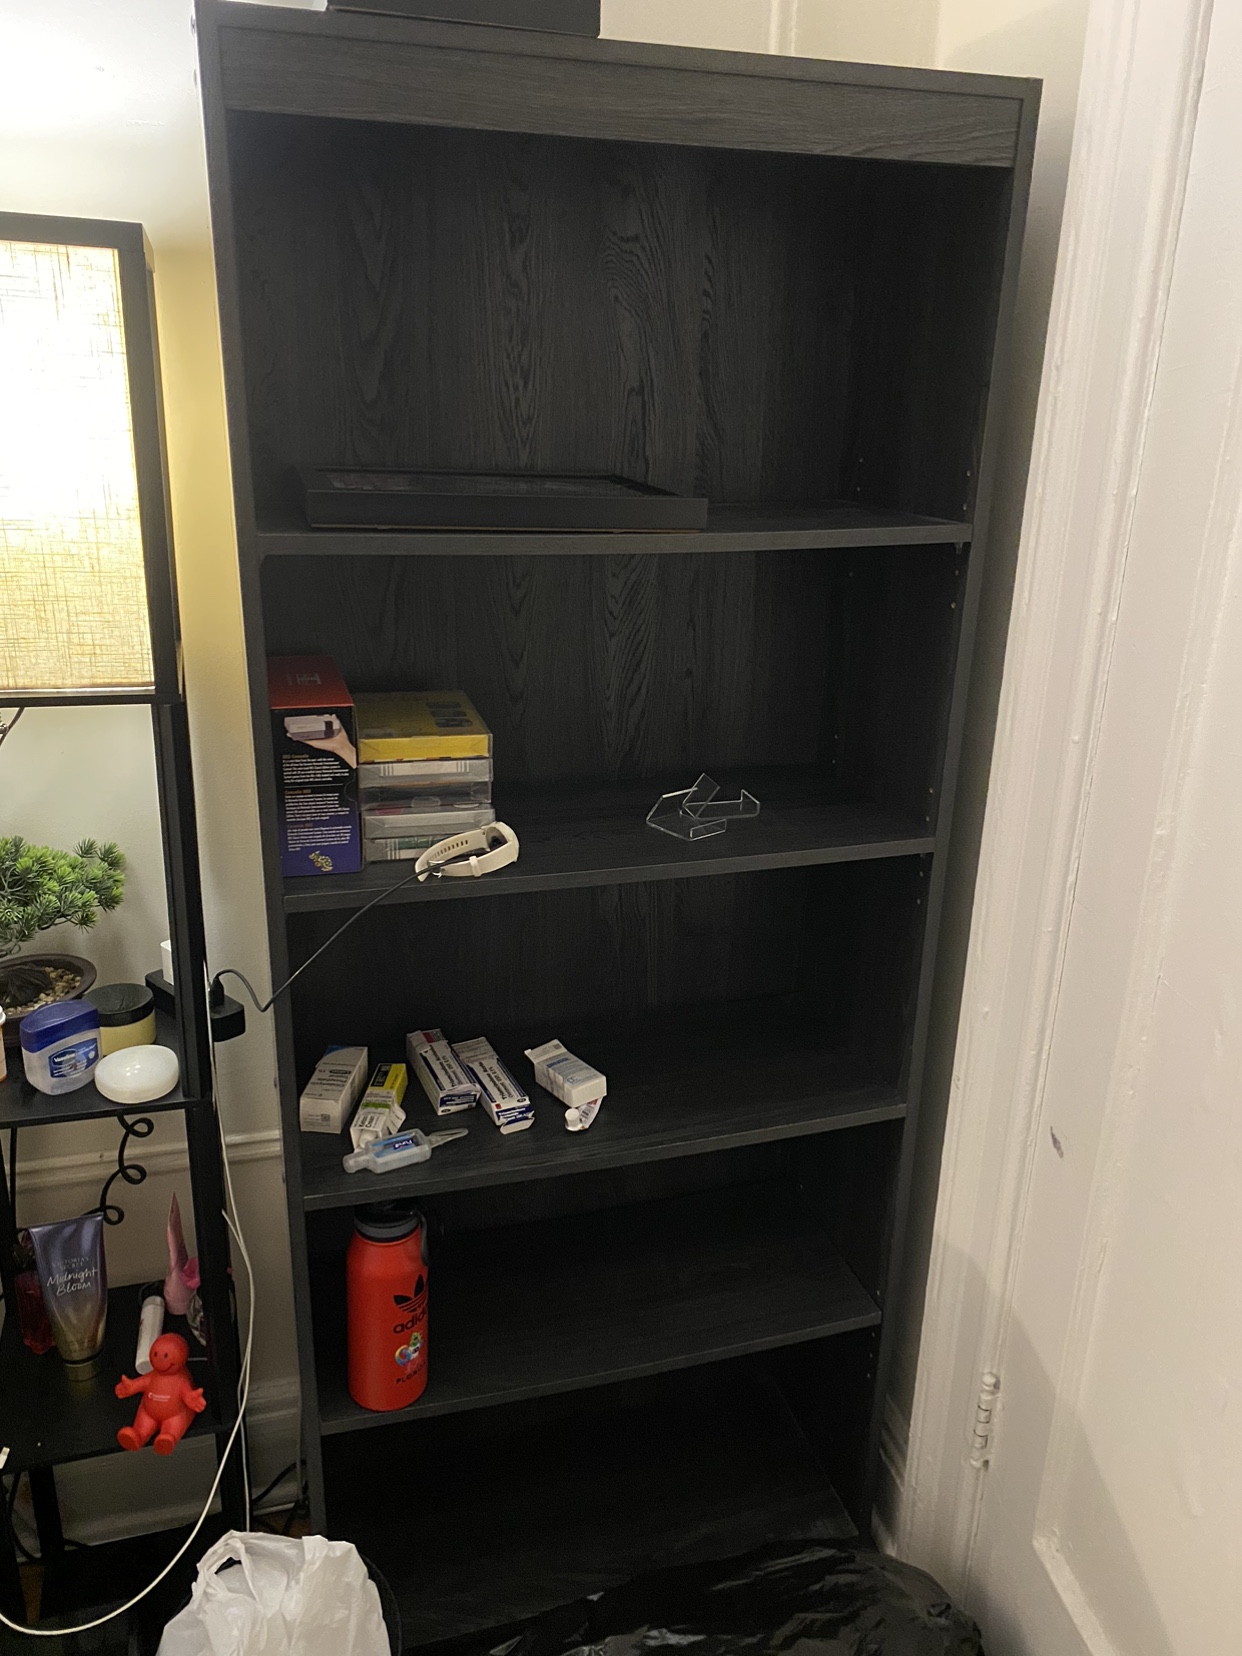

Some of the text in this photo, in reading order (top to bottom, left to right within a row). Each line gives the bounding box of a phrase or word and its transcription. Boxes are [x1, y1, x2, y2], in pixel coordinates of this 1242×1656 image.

[46, 1267, 99, 1287] Midnight
[56, 1281, 92, 1297] Bloom
[393, 1307, 427, 1334] adid
